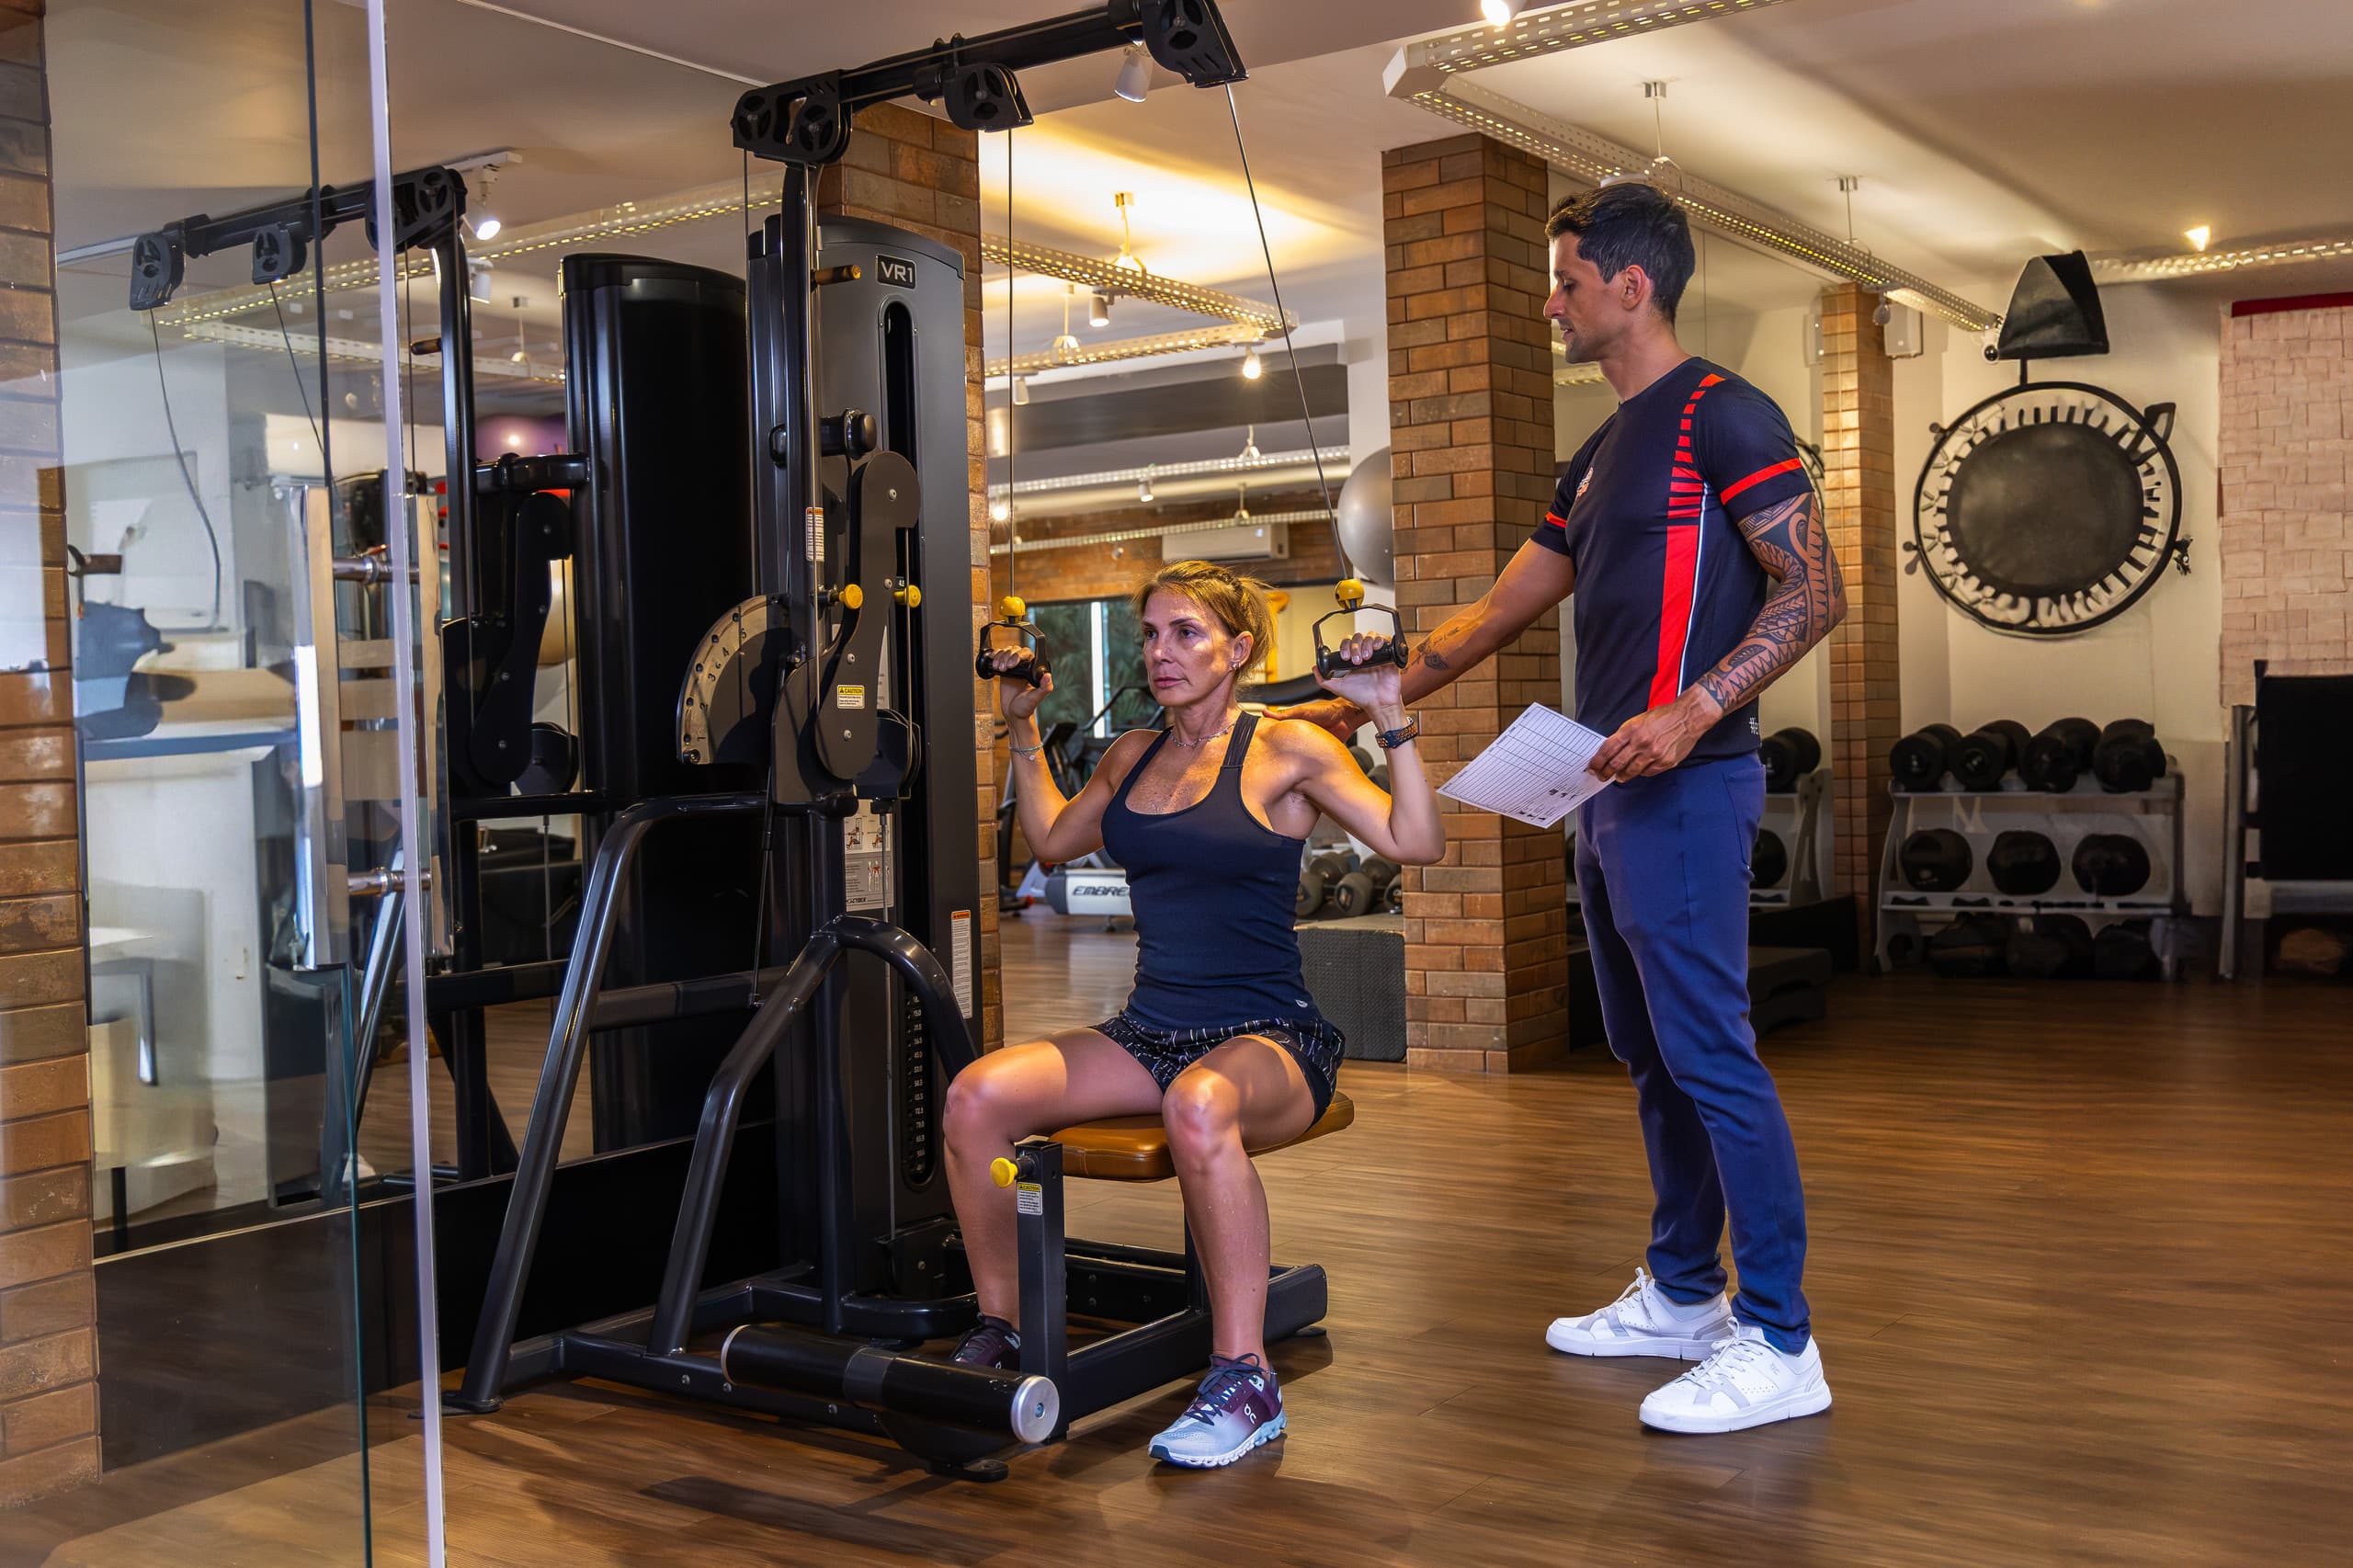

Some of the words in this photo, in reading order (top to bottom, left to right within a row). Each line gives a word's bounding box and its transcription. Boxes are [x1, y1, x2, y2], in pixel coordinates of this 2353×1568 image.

[881, 261, 913, 283] VR1
[722, 646, 730, 657] 4
[708, 673, 716, 682] 3
[1072, 885, 1131, 897] EMBRE
